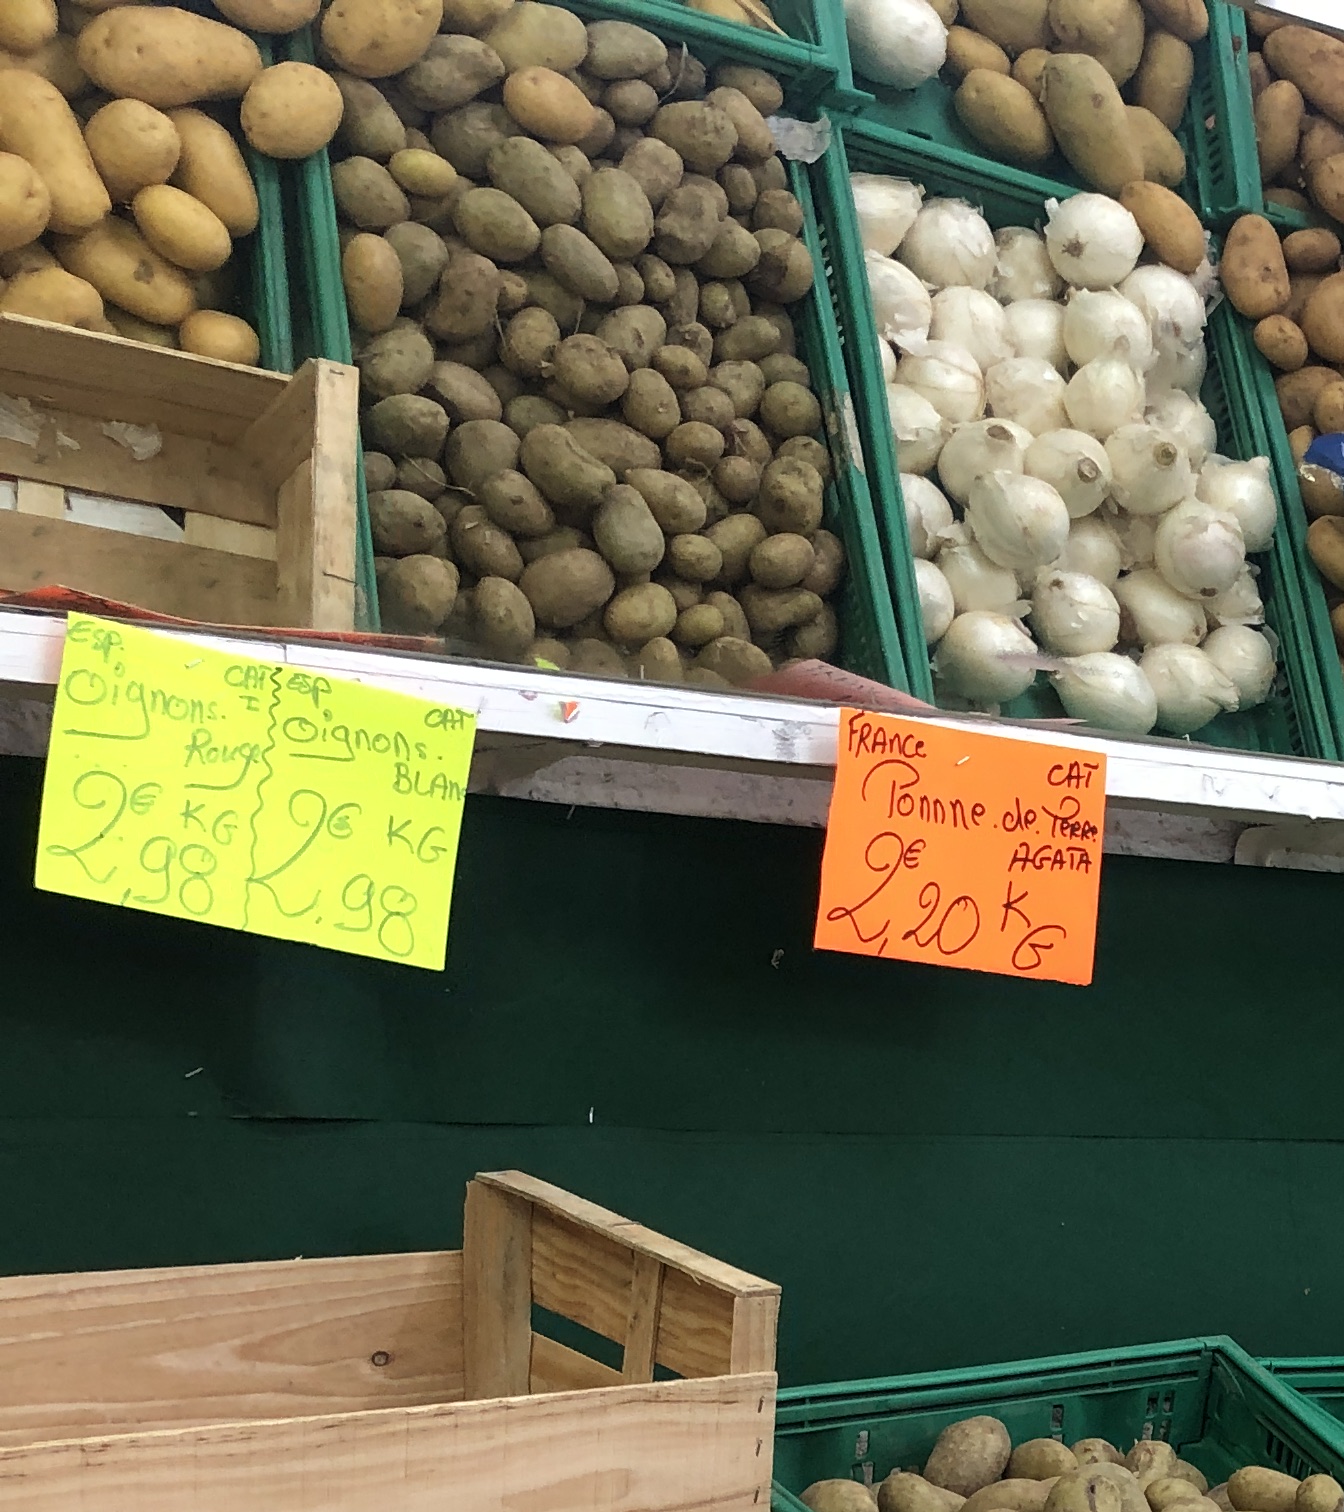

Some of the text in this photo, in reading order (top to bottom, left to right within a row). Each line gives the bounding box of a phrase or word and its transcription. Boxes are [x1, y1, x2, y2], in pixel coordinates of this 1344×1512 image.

[224, 664, 270, 692] CAT
[424, 706, 476, 732] CAT
[1047, 760, 1100, 790] CAT
